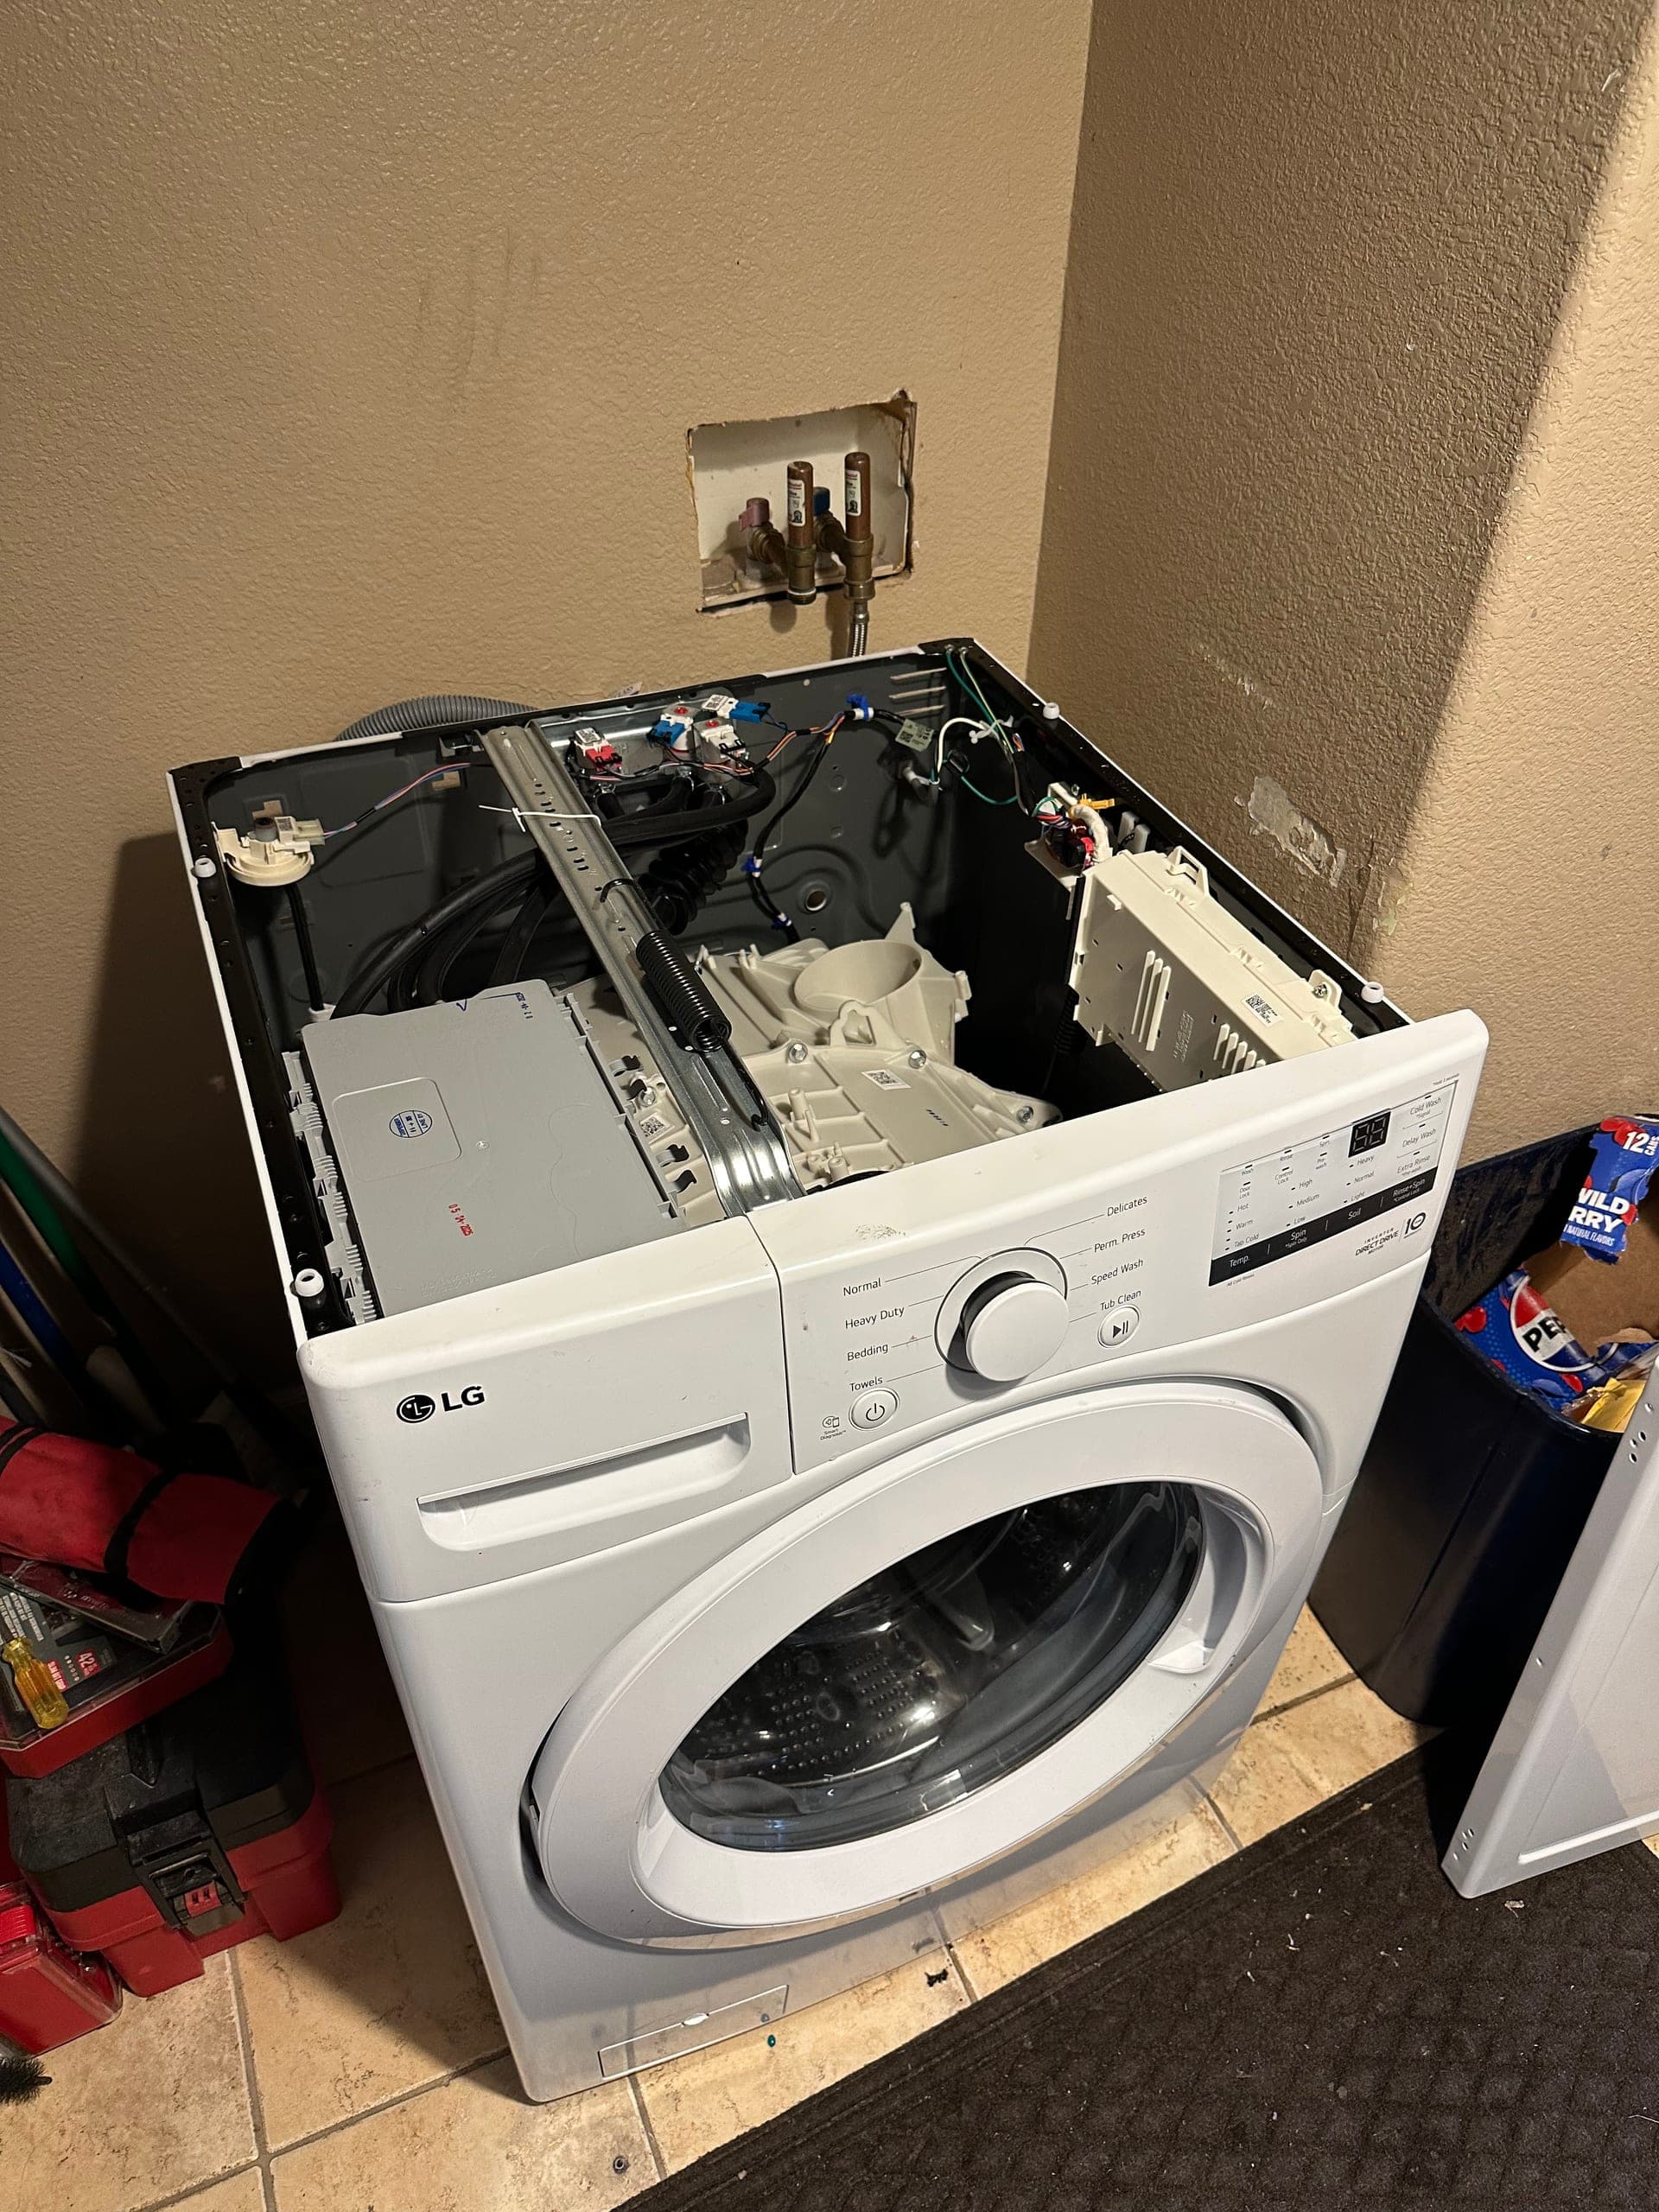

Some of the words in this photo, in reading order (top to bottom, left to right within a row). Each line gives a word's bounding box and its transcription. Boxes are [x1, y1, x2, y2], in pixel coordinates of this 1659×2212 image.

[1409, 1103, 1424, 1115] Cold
[1426, 1096, 1441, 1108] Wash
[1402, 1135, 1419, 1147] Delay
[1421, 1128, 1436, 1139] Wash
[1623, 1131, 1650, 1153] 12
[1280, 1154, 1293, 1162] Rinse
[1357, 1154, 1374, 1166] Heavy
[1396, 1161, 1413, 1173] Extra
[1414, 1154, 1431, 1165] Rinse
[1274, 1169, 1293, 1179] Control
[1353, 1171, 1374, 1183] Normal
[1239, 1185, 1250, 1193] Door
[1299, 1179, 1313, 1189] High
[1296, 1192, 1319, 1206] Medium
[1350, 1191, 1364, 1202] Light
[1107, 1196, 1147, 1217] Delicates
[1237, 1202, 1249, 1211] Hot
[1347, 1207, 1361, 1219] Soil
[1236, 1218, 1253, 1230] Warm
[1294, 1214, 1306, 1224] Low
[1405, 1212, 1426, 1234] 10
[1094, 1237, 1118, 1253] Perm.
[1122, 1227, 1146, 1244] Press
[1245, 1232, 1259, 1243] Cold
[1290, 1227, 1306, 1241] Spin
[1365, 1228, 1393, 1243] INVERTER
[1590, 1231, 1614, 1246] FLAVORS
[1356, 1239, 1379, 1255] DIRECT
[1380, 1230, 1399, 1244] DRIVE
[1229, 1253, 1249, 1269] Temp.
[1091, 1268, 1118, 1287] Speed
[1120, 1258, 1144, 1276] Wash
[843, 1277, 882, 1296] Normal
[1099, 1298, 1117, 1312] Tub
[1120, 1288, 1142, 1305] Clean
[845, 1312, 876, 1330] Heavy
[880, 1306, 906, 1322] Duty
[847, 1343, 888, 1362] Bedding
[850, 1376, 883, 1392] Towels
[441, 1386, 486, 1412] LG
[79, 1652, 95, 1668] 42
